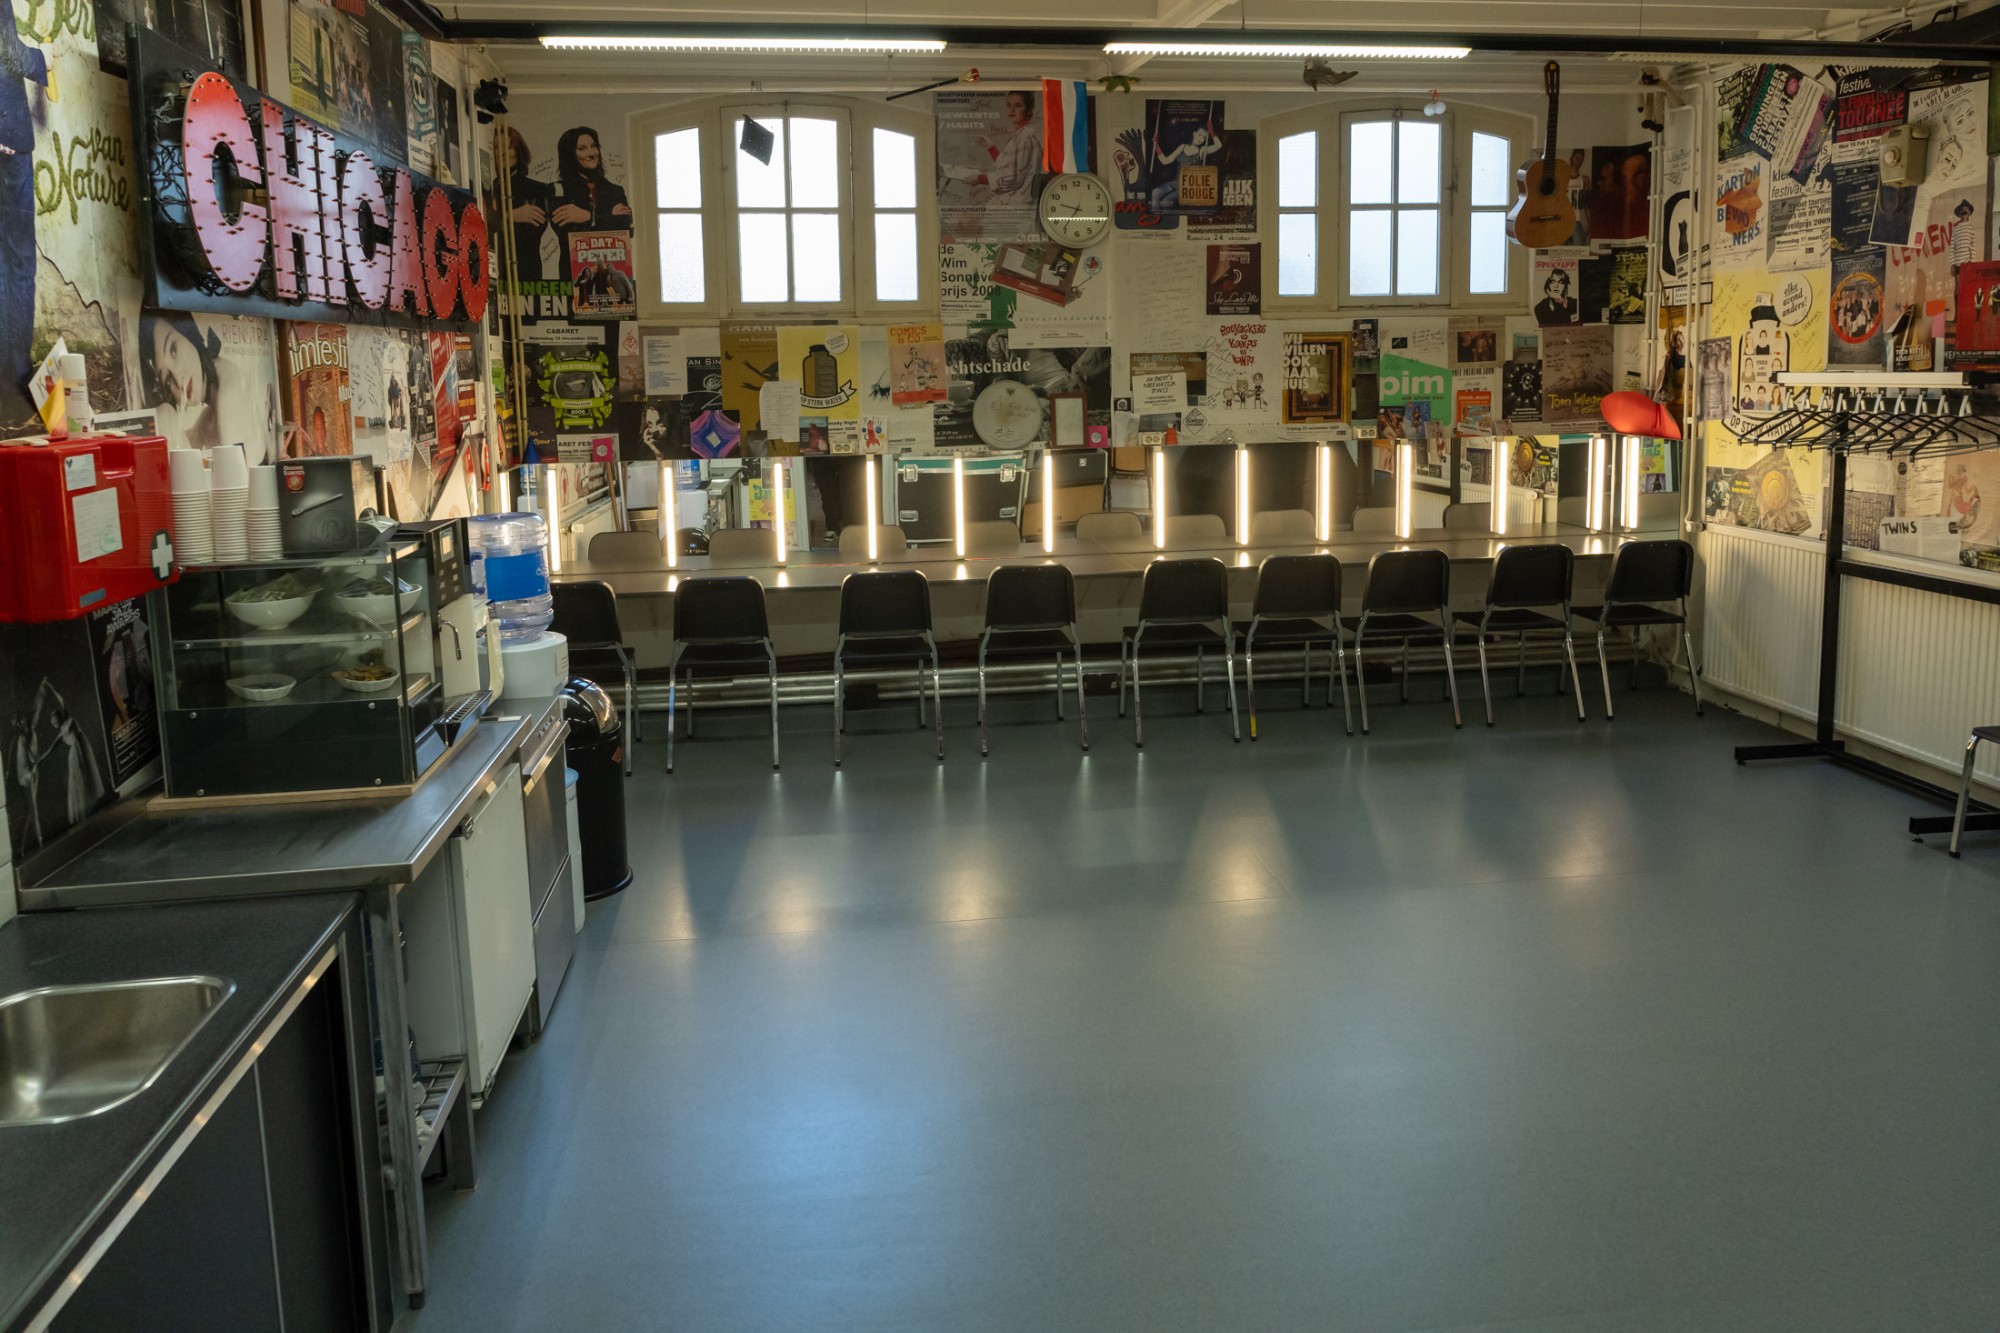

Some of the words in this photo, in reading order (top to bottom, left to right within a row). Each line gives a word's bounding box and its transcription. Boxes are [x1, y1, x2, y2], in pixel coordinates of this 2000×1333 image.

[1749, 69, 1782, 142] GRONINGER
[1756, 71, 1789, 146] STUDENTEN
[1761, 92, 1788, 150] CABARET
[1838, 101, 1905, 130] TOURNEE
[1766, 97, 1794, 154] FESTIVAL
[1182, 174, 1211, 187] FOLIE
[1717, 162, 1761, 199] KARTON
[182, 71, 490, 324] CHICAGO
[1182, 187, 1215, 200] ROUGE
[1771, 183, 1802, 198] festival
[1050, 205, 1056, 213] 9
[1097, 205, 1104, 213] 3
[1717, 207, 1750, 227] BEWO
[1732, 221, 1761, 246] NERS
[590, 238, 613, 248] DAT
[940, 244, 954, 254] de
[577, 249, 626, 263] PETER
[940, 257, 967, 268] Wim
[940, 285, 968, 300] prijs
[971, 285, 1002, 297] 2008
[1782, 288, 1803, 306] avond
[1783, 282, 1799, 298] elke
[540, 296, 568, 316] EN
[1782, 296, 1808, 317] anders!
[222, 323, 269, 346] RIENSTRA
[890, 326, 928, 336] COMICS
[907, 335, 921, 343] CO
[1283, 334, 1303, 344] WIJ
[1282, 344, 1327, 356] WILLEN
[951, 357, 1031, 375] chtschade
[1281, 356, 1311, 367] OOK
[1281, 367, 1318, 378] NAAR
[1380, 370, 1445, 402] pim
[825, 396, 843, 406] WATER
[1547, 393, 1571, 409] Toon
[1729, 415, 1741, 428] OP
[1881, 520, 1918, 537] TWINS
